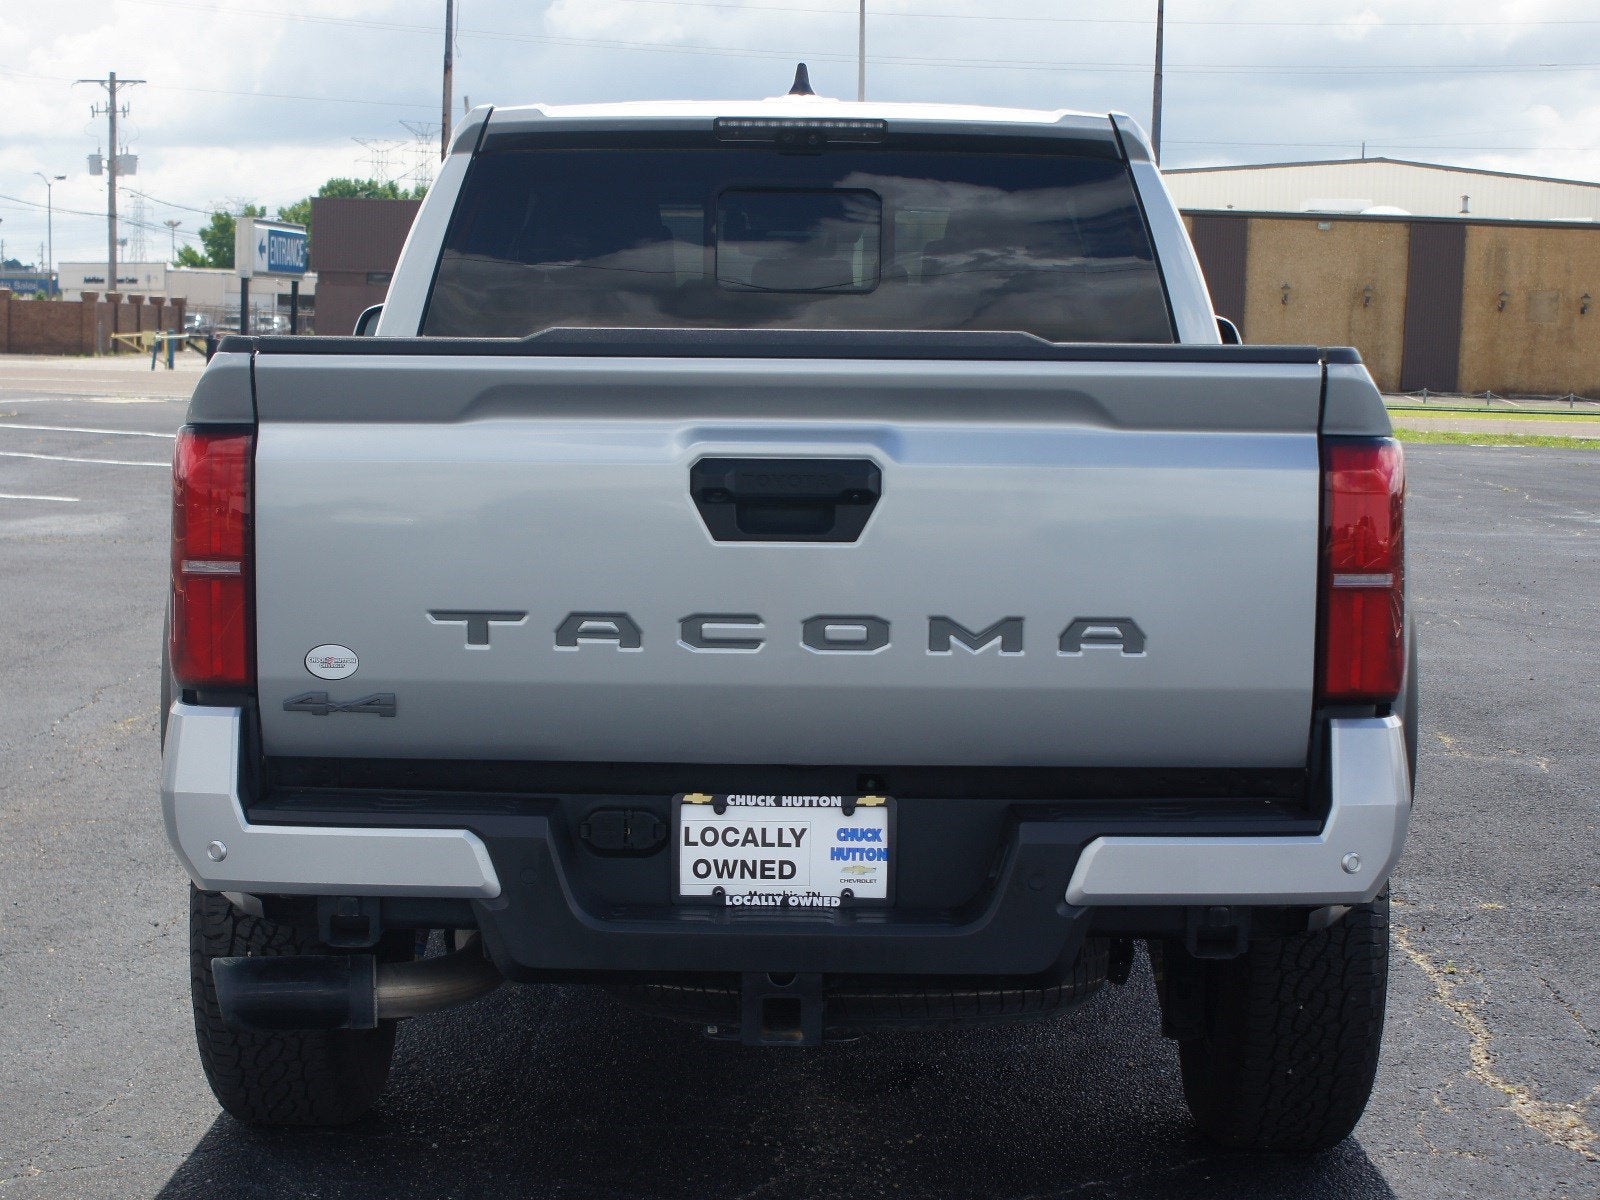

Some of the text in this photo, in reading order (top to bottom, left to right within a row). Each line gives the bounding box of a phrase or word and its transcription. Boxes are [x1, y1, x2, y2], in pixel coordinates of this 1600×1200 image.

[270, 236, 304, 268] ENTRANCE
[426, 609, 1147, 658] TACOMA
[726, 794, 842, 807] CHUCK HUTTON
[684, 826, 807, 848] LOCALLY
[836, 828, 883, 843] CHUCK
[830, 847, 889, 862] HUTTON
[692, 858, 797, 880] OWNED
[725, 895, 841, 907] LOCALLY OWNED
